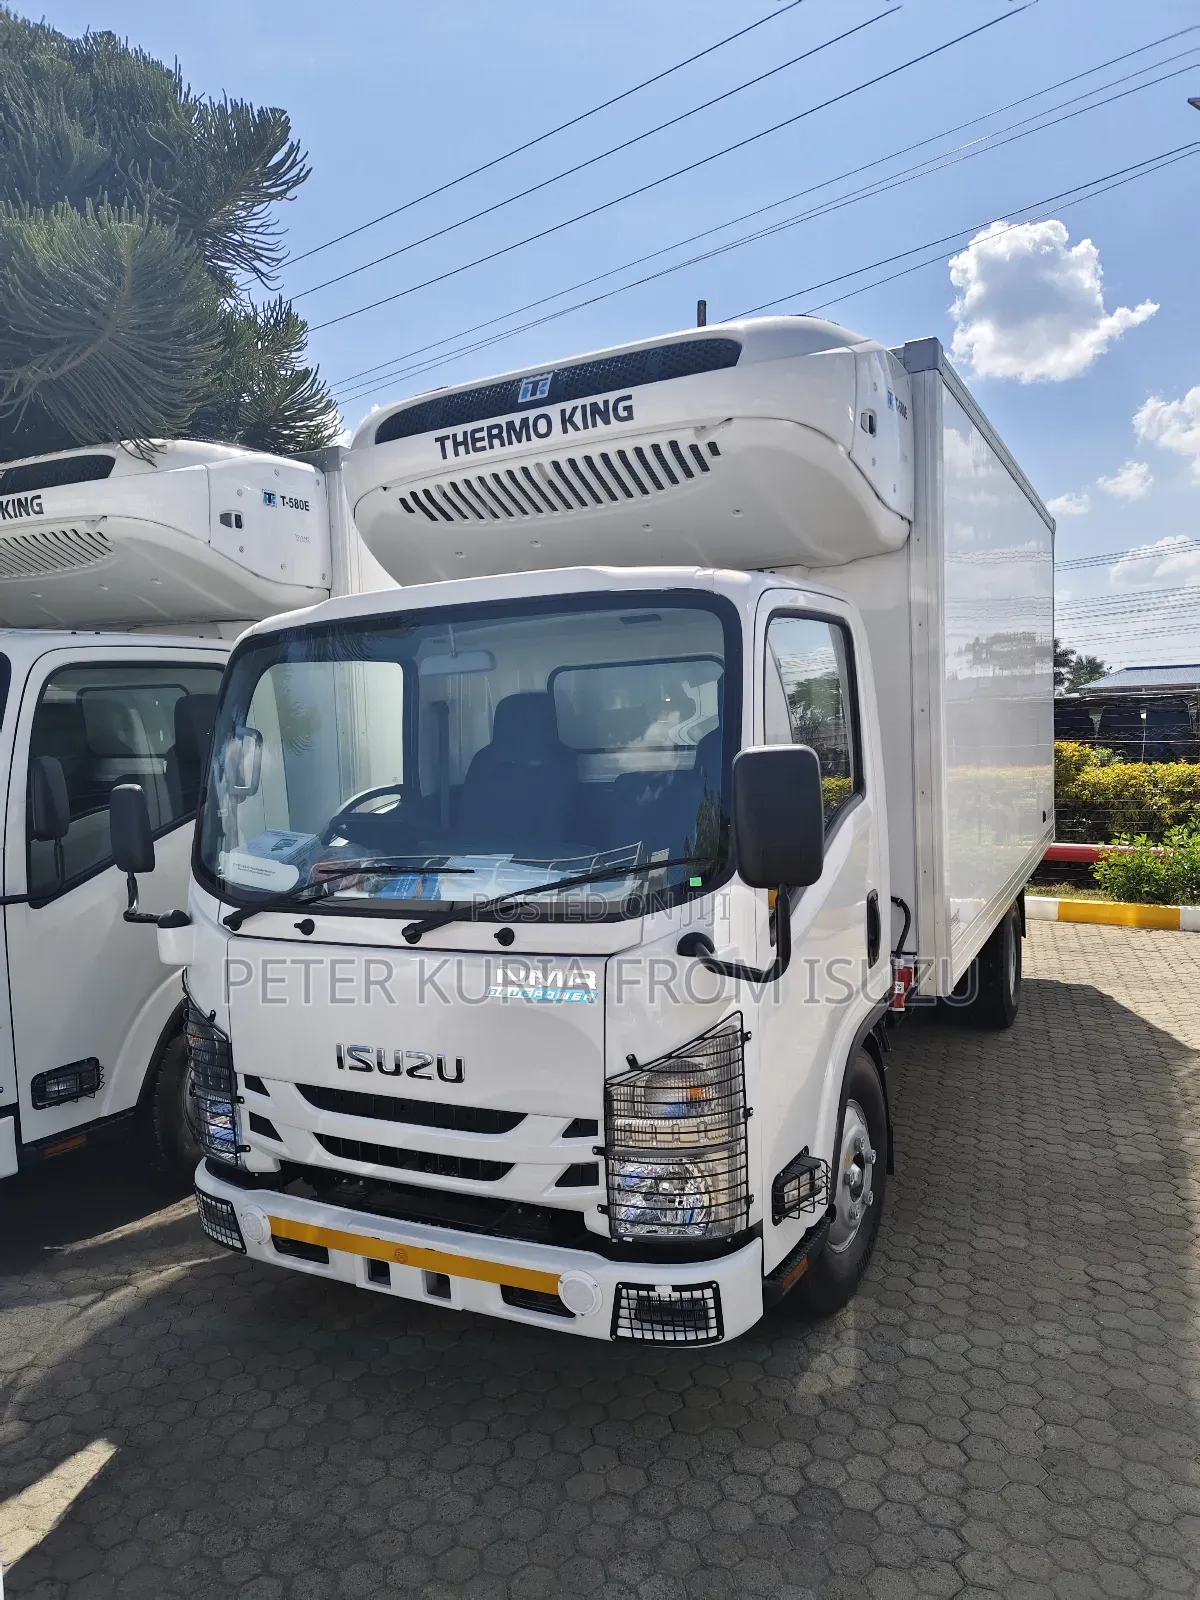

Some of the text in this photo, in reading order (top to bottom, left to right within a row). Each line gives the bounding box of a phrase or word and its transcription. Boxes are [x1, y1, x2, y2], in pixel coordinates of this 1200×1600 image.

[435, 394, 634, 460] THERMO KING
[0, 495, 44, 520] KING
[280, 495, 310, 512] T-580E
[336, 1042, 466, 1083] ISUZU
